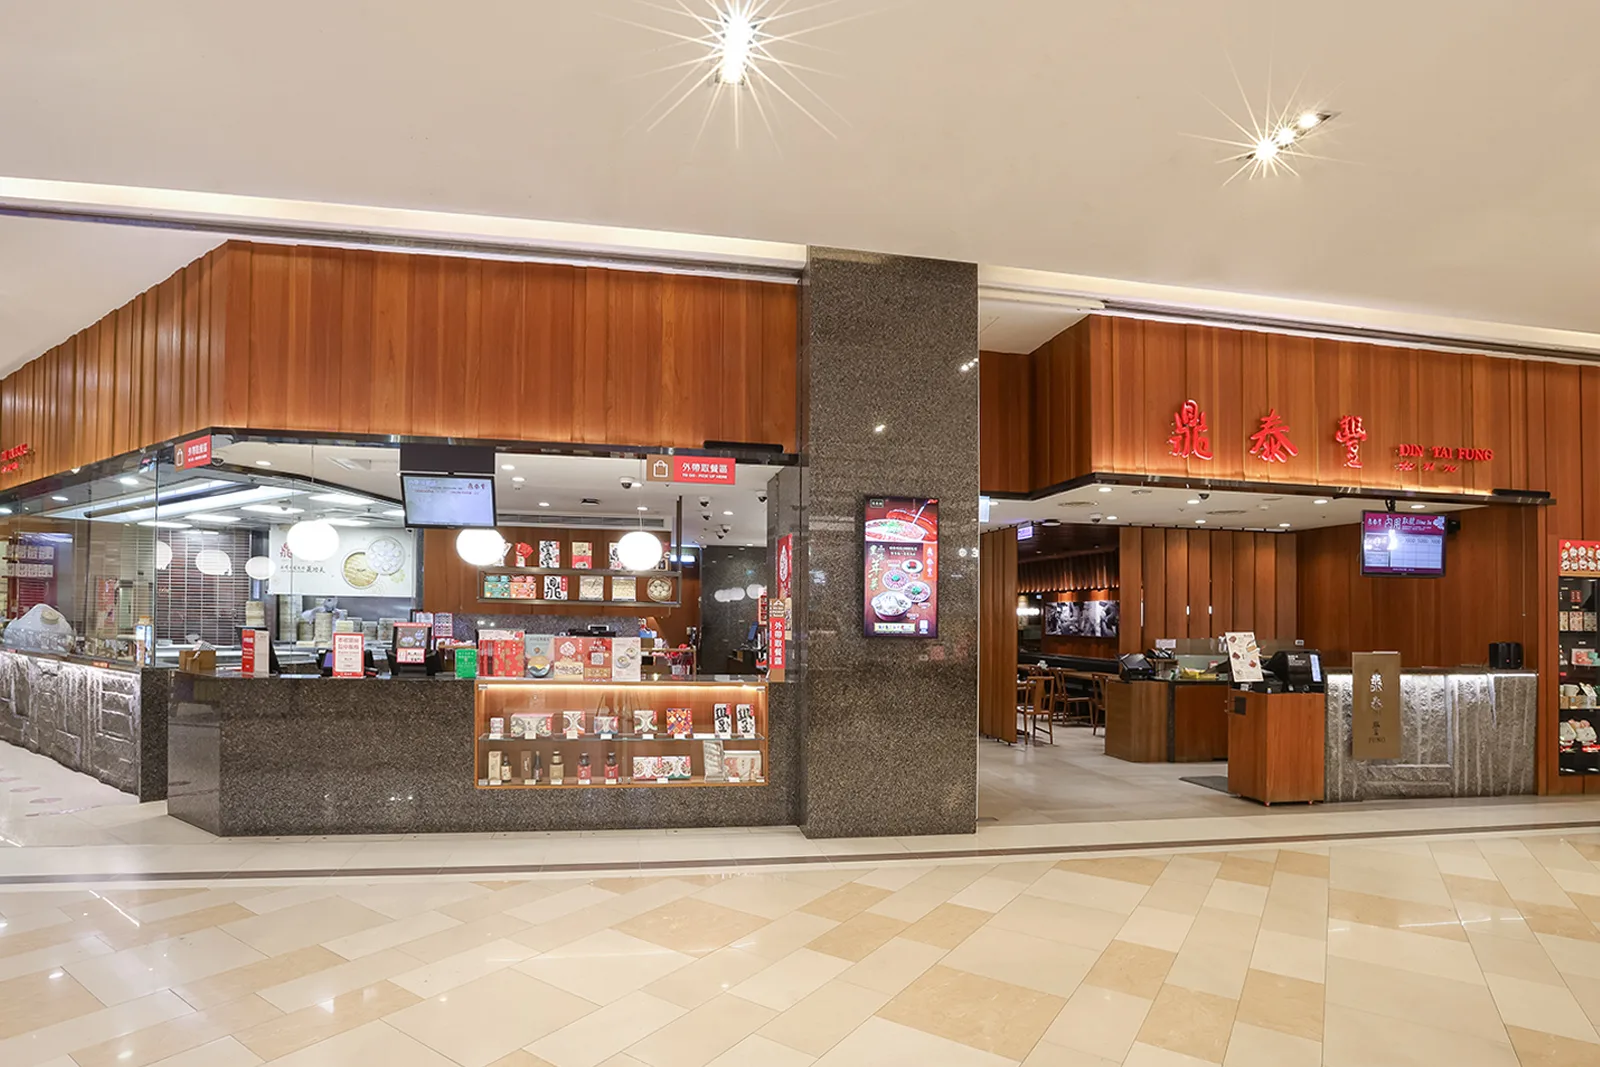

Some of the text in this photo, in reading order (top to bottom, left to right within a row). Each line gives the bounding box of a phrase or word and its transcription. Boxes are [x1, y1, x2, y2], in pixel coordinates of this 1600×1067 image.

[1168, 399, 1368, 469] 鼎泰豐
[1399, 444, 1494, 461] DIN TAI FUNG
[682, 462, 728, 474] 外帶取餐區
